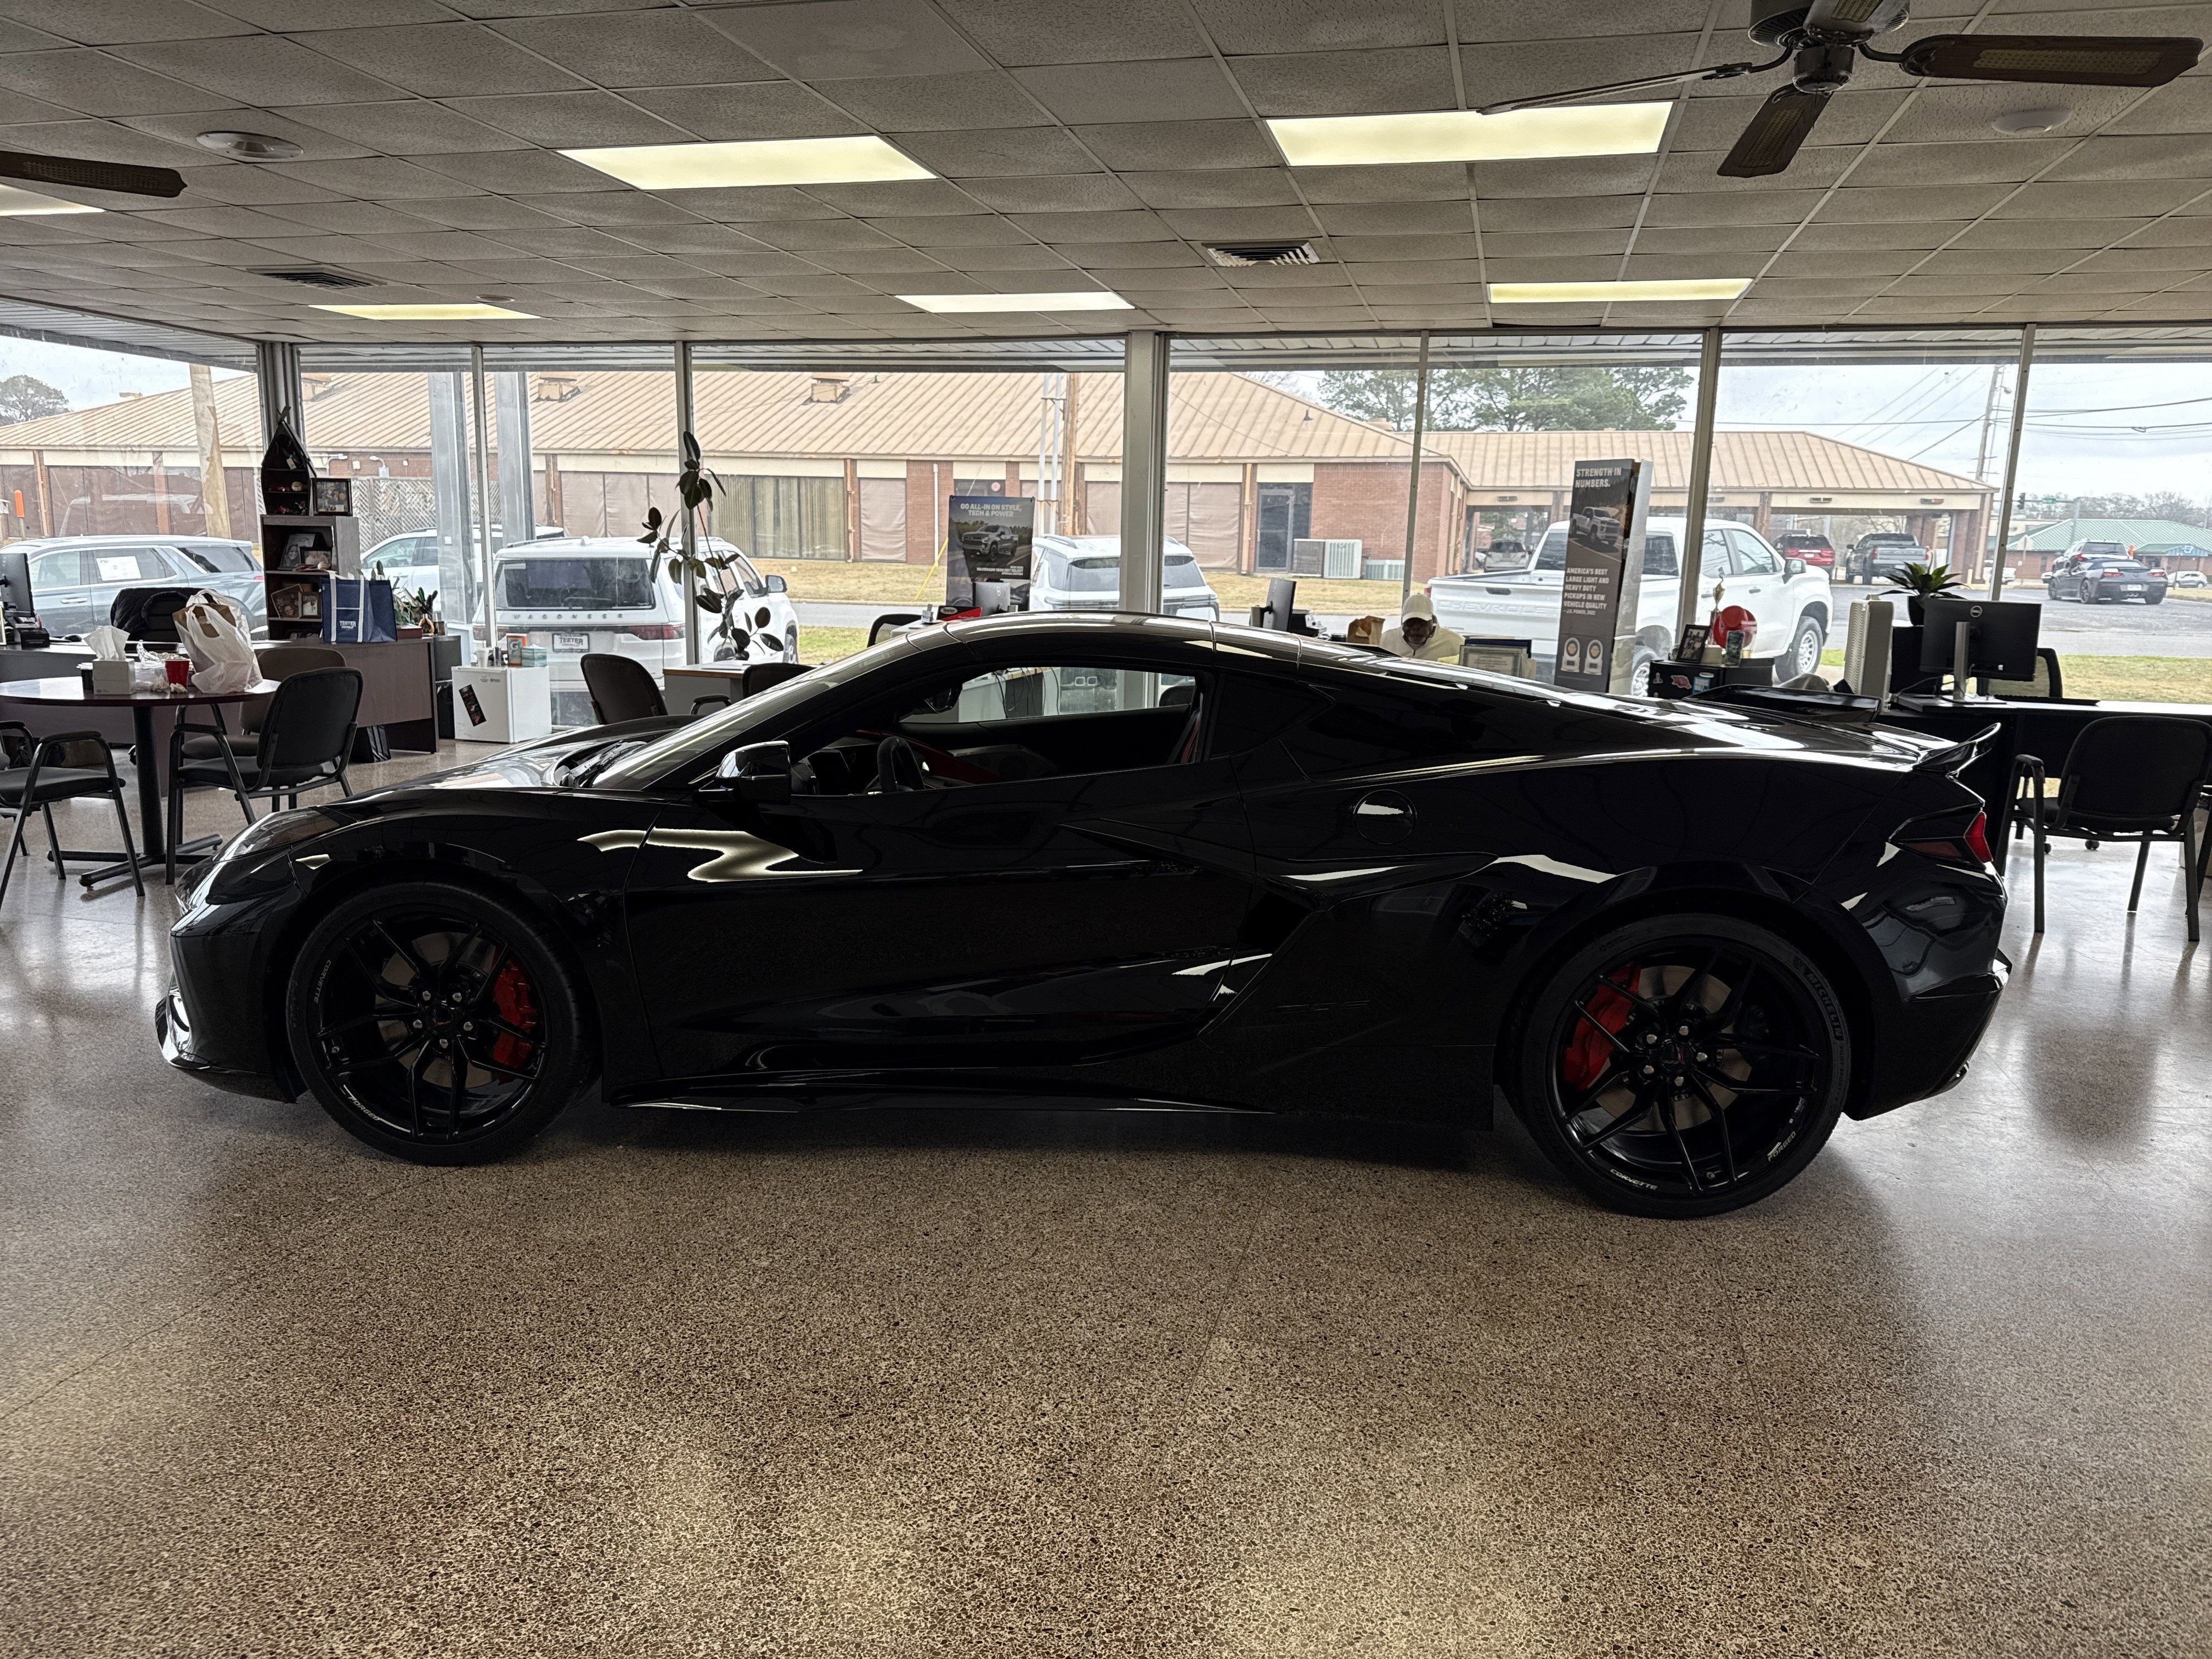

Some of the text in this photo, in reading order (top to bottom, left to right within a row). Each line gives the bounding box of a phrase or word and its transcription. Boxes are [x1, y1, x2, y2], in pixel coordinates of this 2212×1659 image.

[1575, 478, 1611, 488] NUMBERS.
[1576, 467, 1622, 477] STRENGTH IN
[559, 637, 583, 645] TEETER
[314, 960, 332, 1003] CORVETTE
[1806, 973, 1843, 1036] MICHELIN
[348, 1097, 380, 1121] FORGED
[1767, 1131, 1796, 1162] FORGED
[1610, 1168, 1658, 1190] CORVETTE
